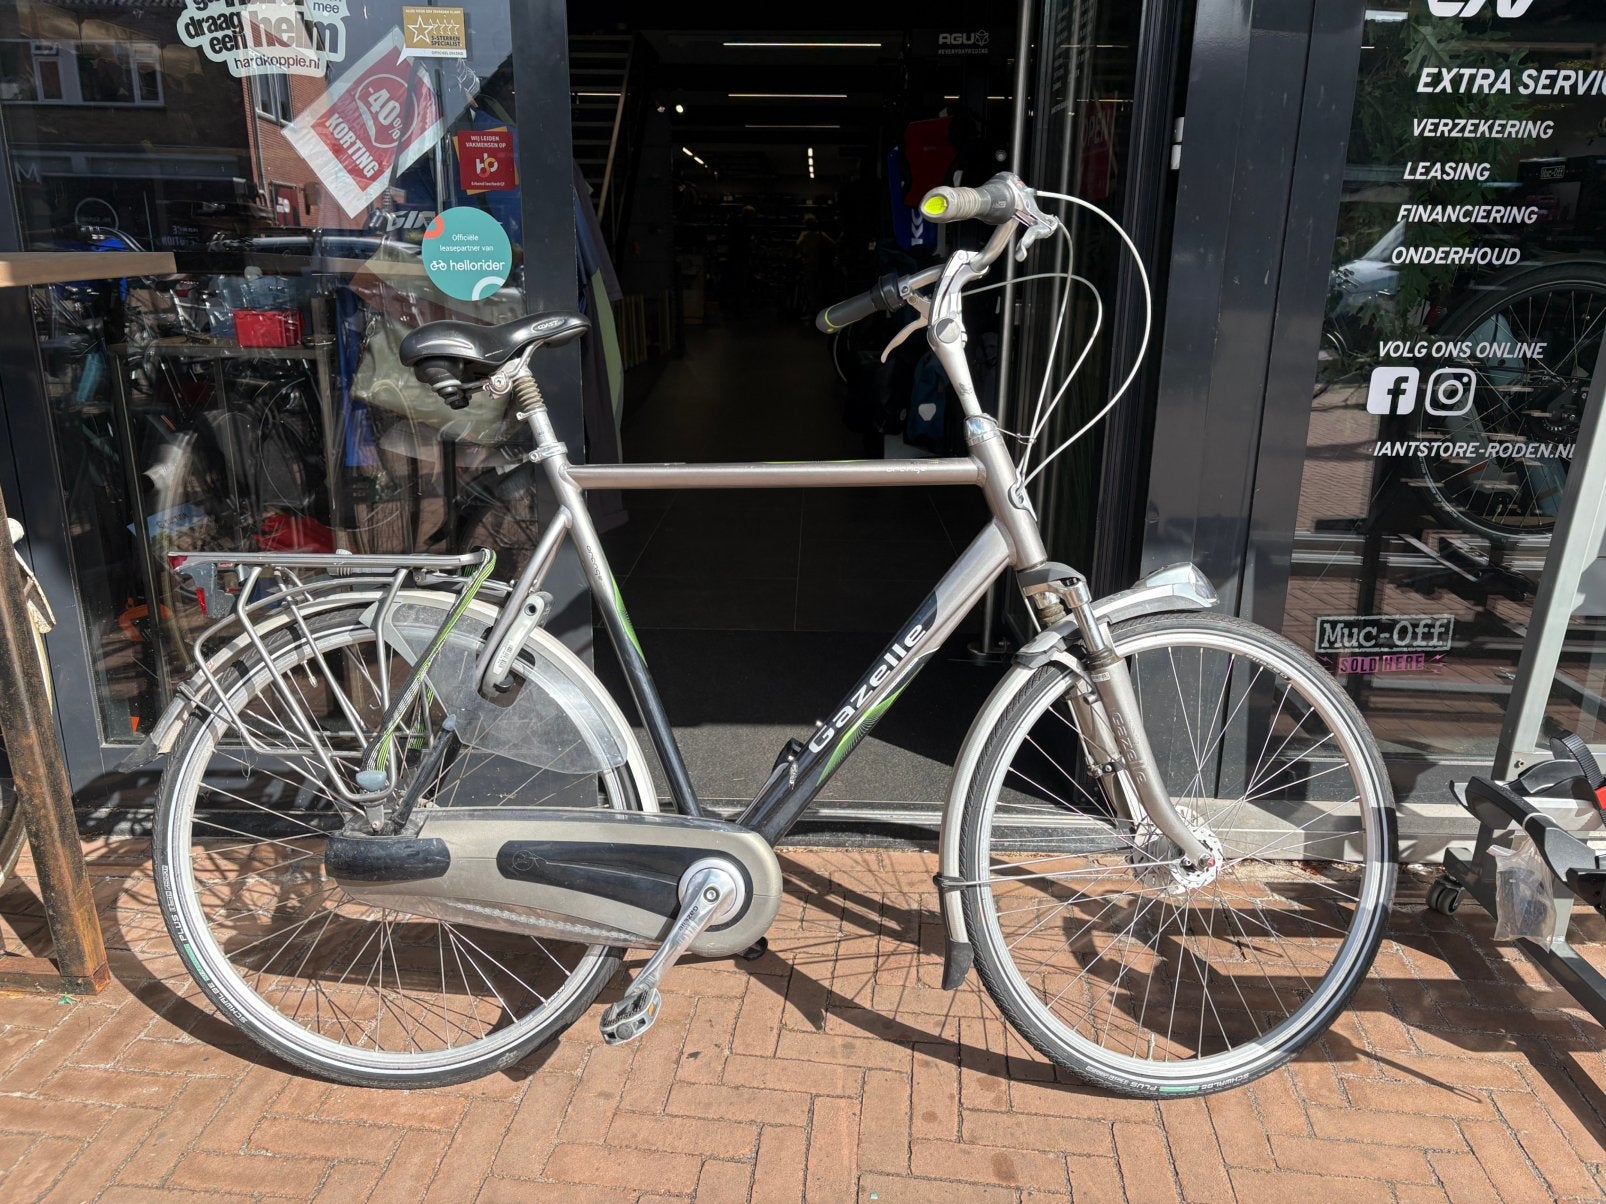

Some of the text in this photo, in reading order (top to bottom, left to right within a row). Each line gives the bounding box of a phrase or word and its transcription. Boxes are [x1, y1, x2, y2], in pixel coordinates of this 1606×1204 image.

[313, 2, 340, 14] mee
[184, 12, 246, 40] draag
[249, 11, 339, 54] helm
[209, 32, 249, 55] een
[938, 33, 975, 45] AGU
[1416, 67, 1511, 94] EXTRA
[1413, 118, 1555, 140] VERZEKERING
[325, 113, 380, 178] KORTING
[1403, 162, 1491, 181] LEASING
[1397, 204, 1540, 224] FINANCIERING
[439, 245, 481, 253] leasepartner
[1391, 247, 1521, 265] ONDERHOUD
[450, 260, 506, 271] hellorider
[1379, 341, 1548, 359] VOLG ONS ONLINE
[1321, 618, 1448, 648] Muc-Off
[1340, 654, 1424, 673] SOLD HERE
[808, 624, 926, 754] Gazelle
